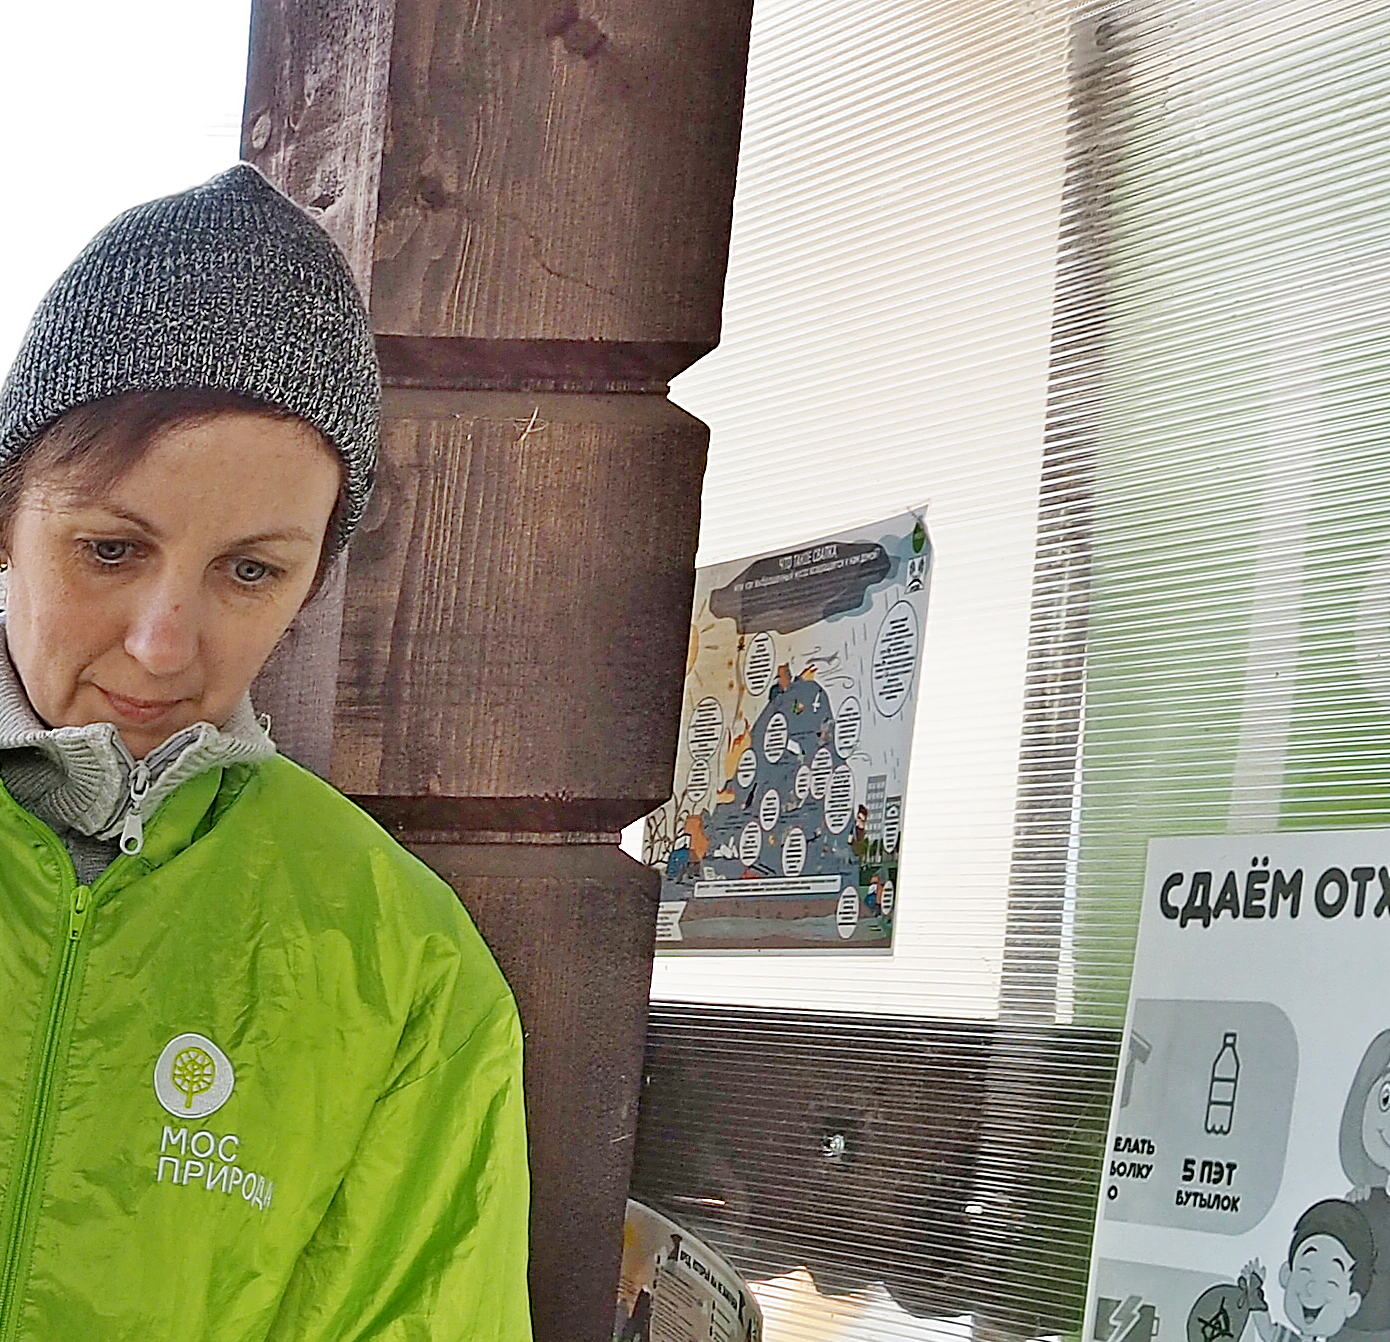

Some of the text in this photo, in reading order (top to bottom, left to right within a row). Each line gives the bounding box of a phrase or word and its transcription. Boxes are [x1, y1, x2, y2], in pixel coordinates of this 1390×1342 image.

[1160, 856, 1304, 929] СДАЁМ
[160, 1126, 239, 1163] МОС
[1181, 1158, 1238, 1186] 5 ПЭТ
[1175, 1189, 1241, 1213] БУТЫЛОК
